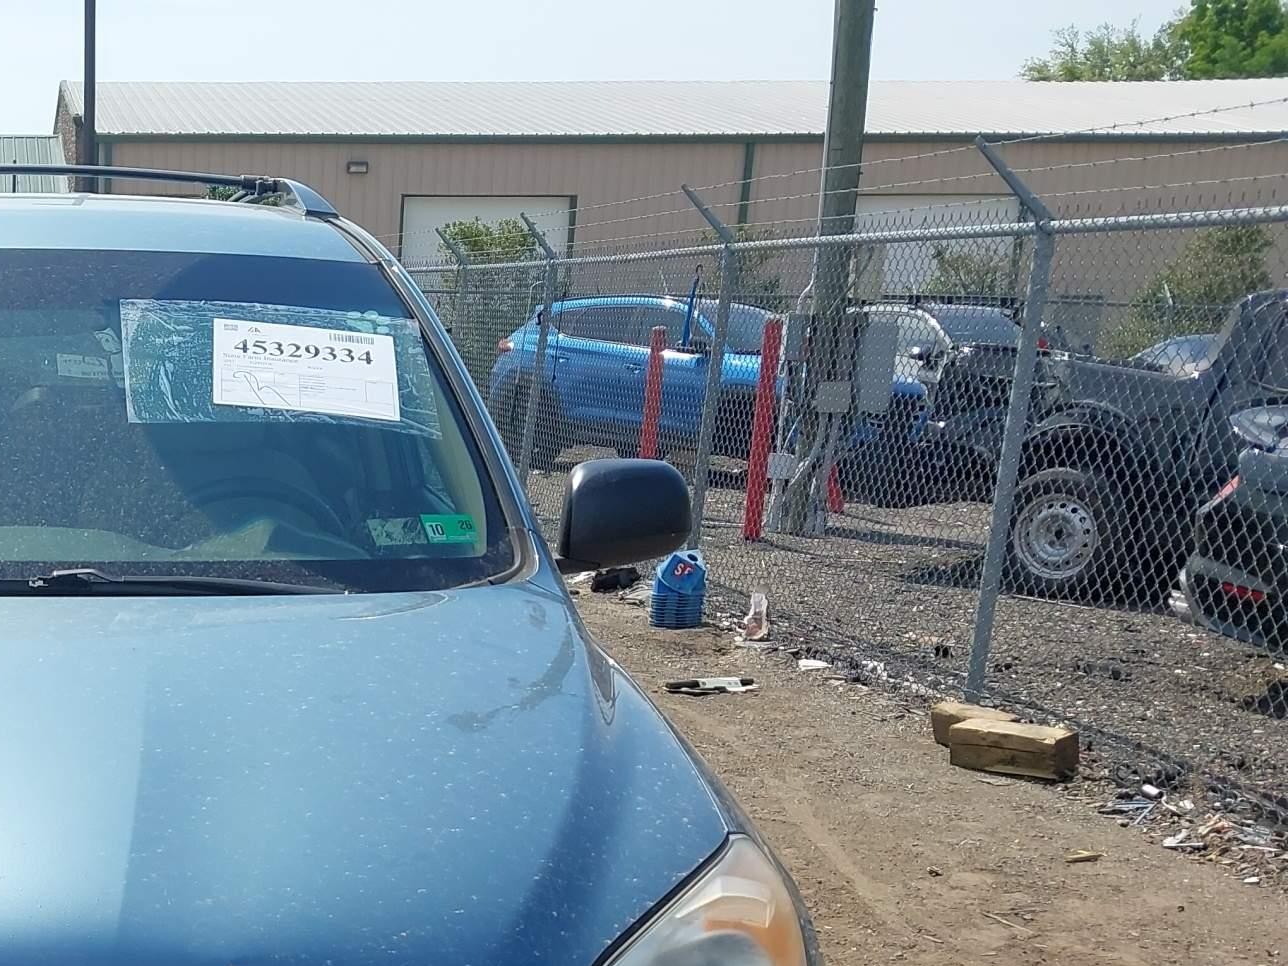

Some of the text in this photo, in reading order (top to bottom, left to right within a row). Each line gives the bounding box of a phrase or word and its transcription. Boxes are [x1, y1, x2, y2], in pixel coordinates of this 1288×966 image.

[234, 338, 373, 365] 45329334
[428, 520, 472, 536] 10 26
